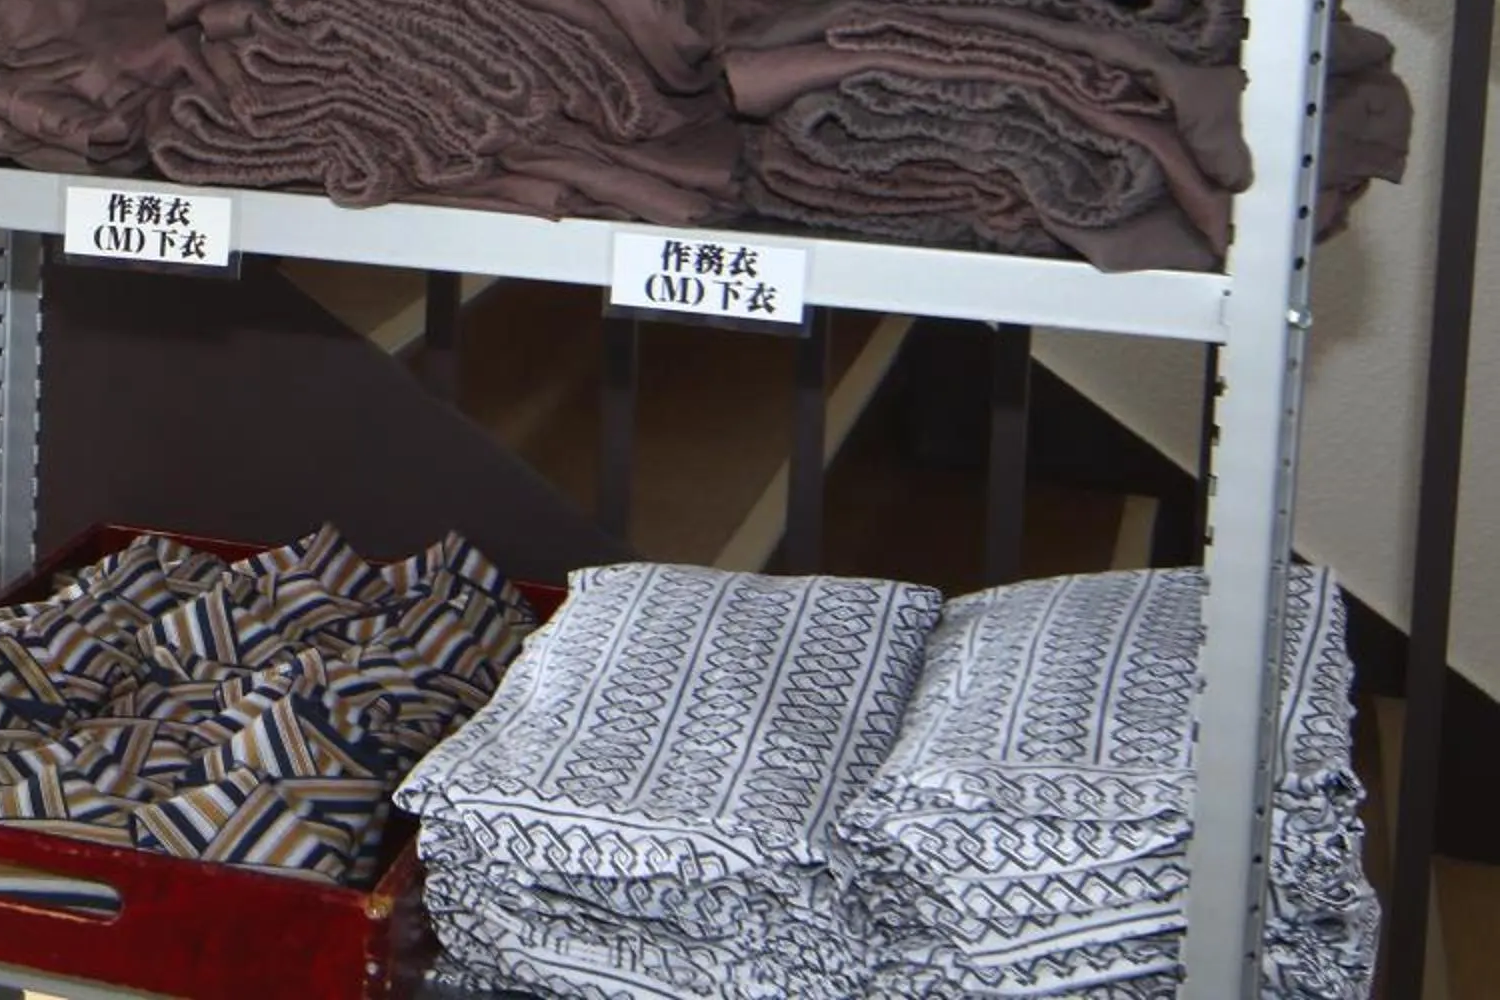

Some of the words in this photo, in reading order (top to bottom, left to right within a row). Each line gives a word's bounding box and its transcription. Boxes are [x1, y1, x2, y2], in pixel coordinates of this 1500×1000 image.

[108, 193, 190, 226] 作務衣
[93, 225, 206, 259] (M)下衣
[661, 240, 758, 278] 作務衣
[644, 273, 776, 314] (M)下衣
